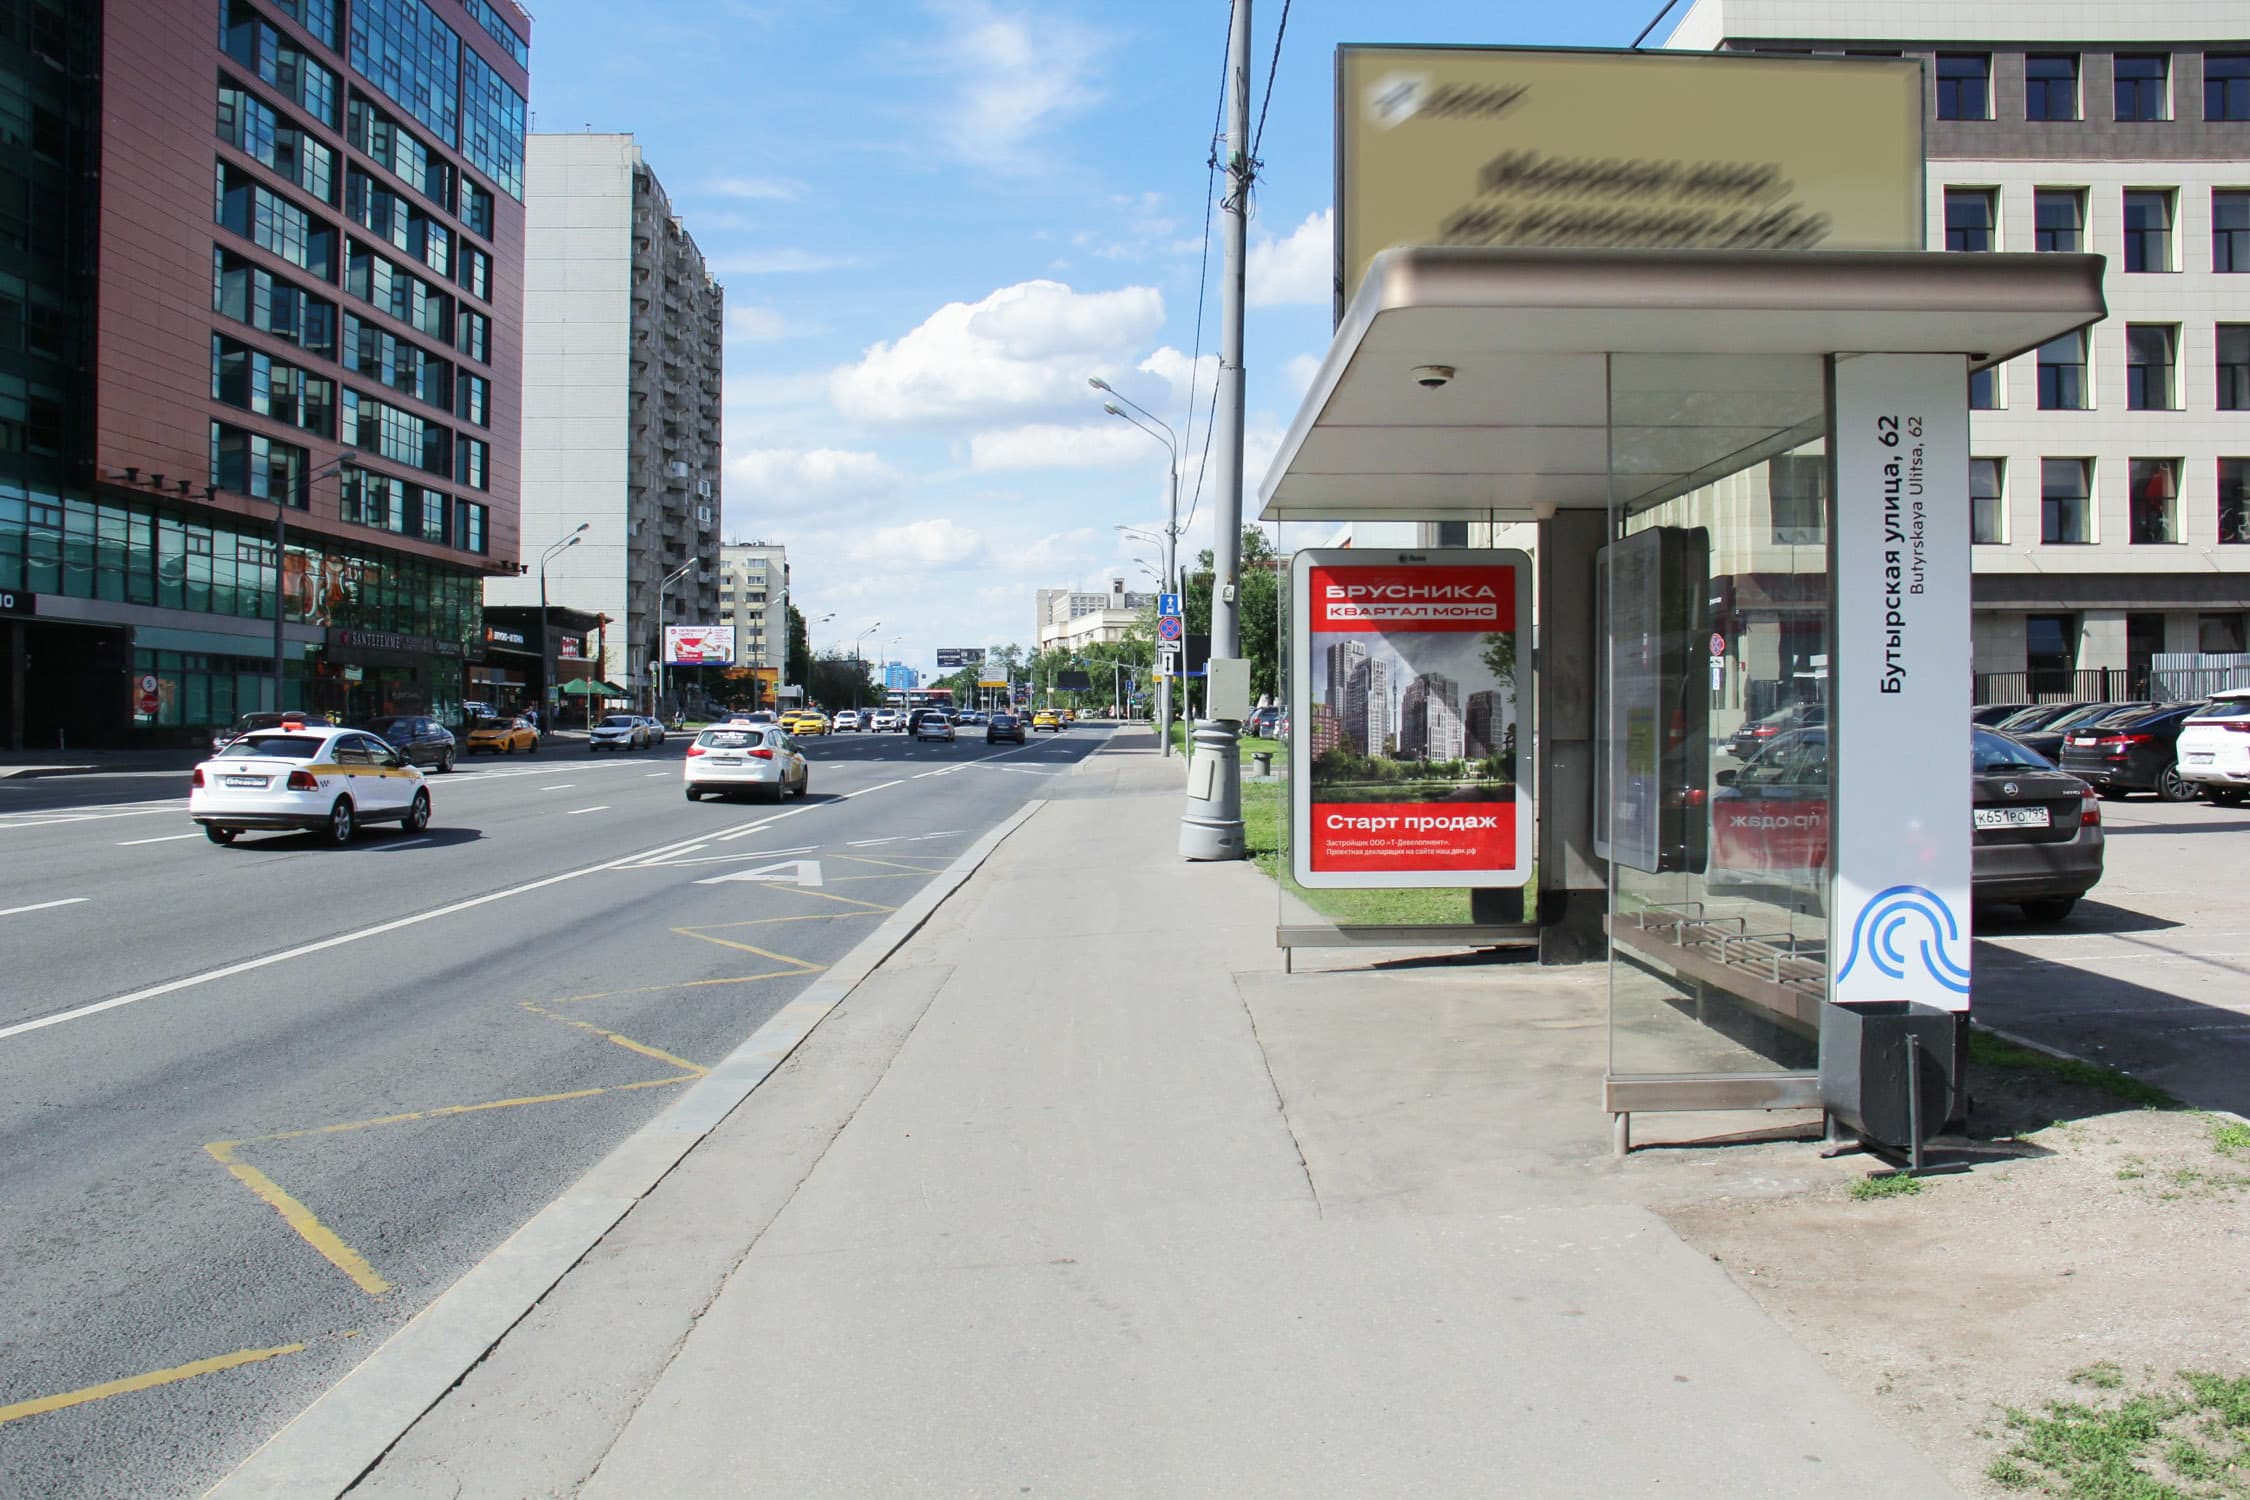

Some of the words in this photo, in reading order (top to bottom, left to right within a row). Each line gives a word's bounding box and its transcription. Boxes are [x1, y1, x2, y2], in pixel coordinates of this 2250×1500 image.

[1878, 415, 1899, 447] 62
[1908, 416, 1922, 437] 62
[1909, 443, 1924, 496] Ulitsa,
[1884, 456, 1905, 544] улица,
[1910, 501, 1927, 595] Butyrskaya
[1326, 585, 1496, 598] БРУСНИКА
[1330, 607, 1428, 616] КВАРТАЛ
[1433, 607, 1494, 616] МОНС
[1880, 550, 1906, 693] Бутырская
[1326, 814, 1400, 832] Старт
[1405, 815, 1498, 832] продаж
